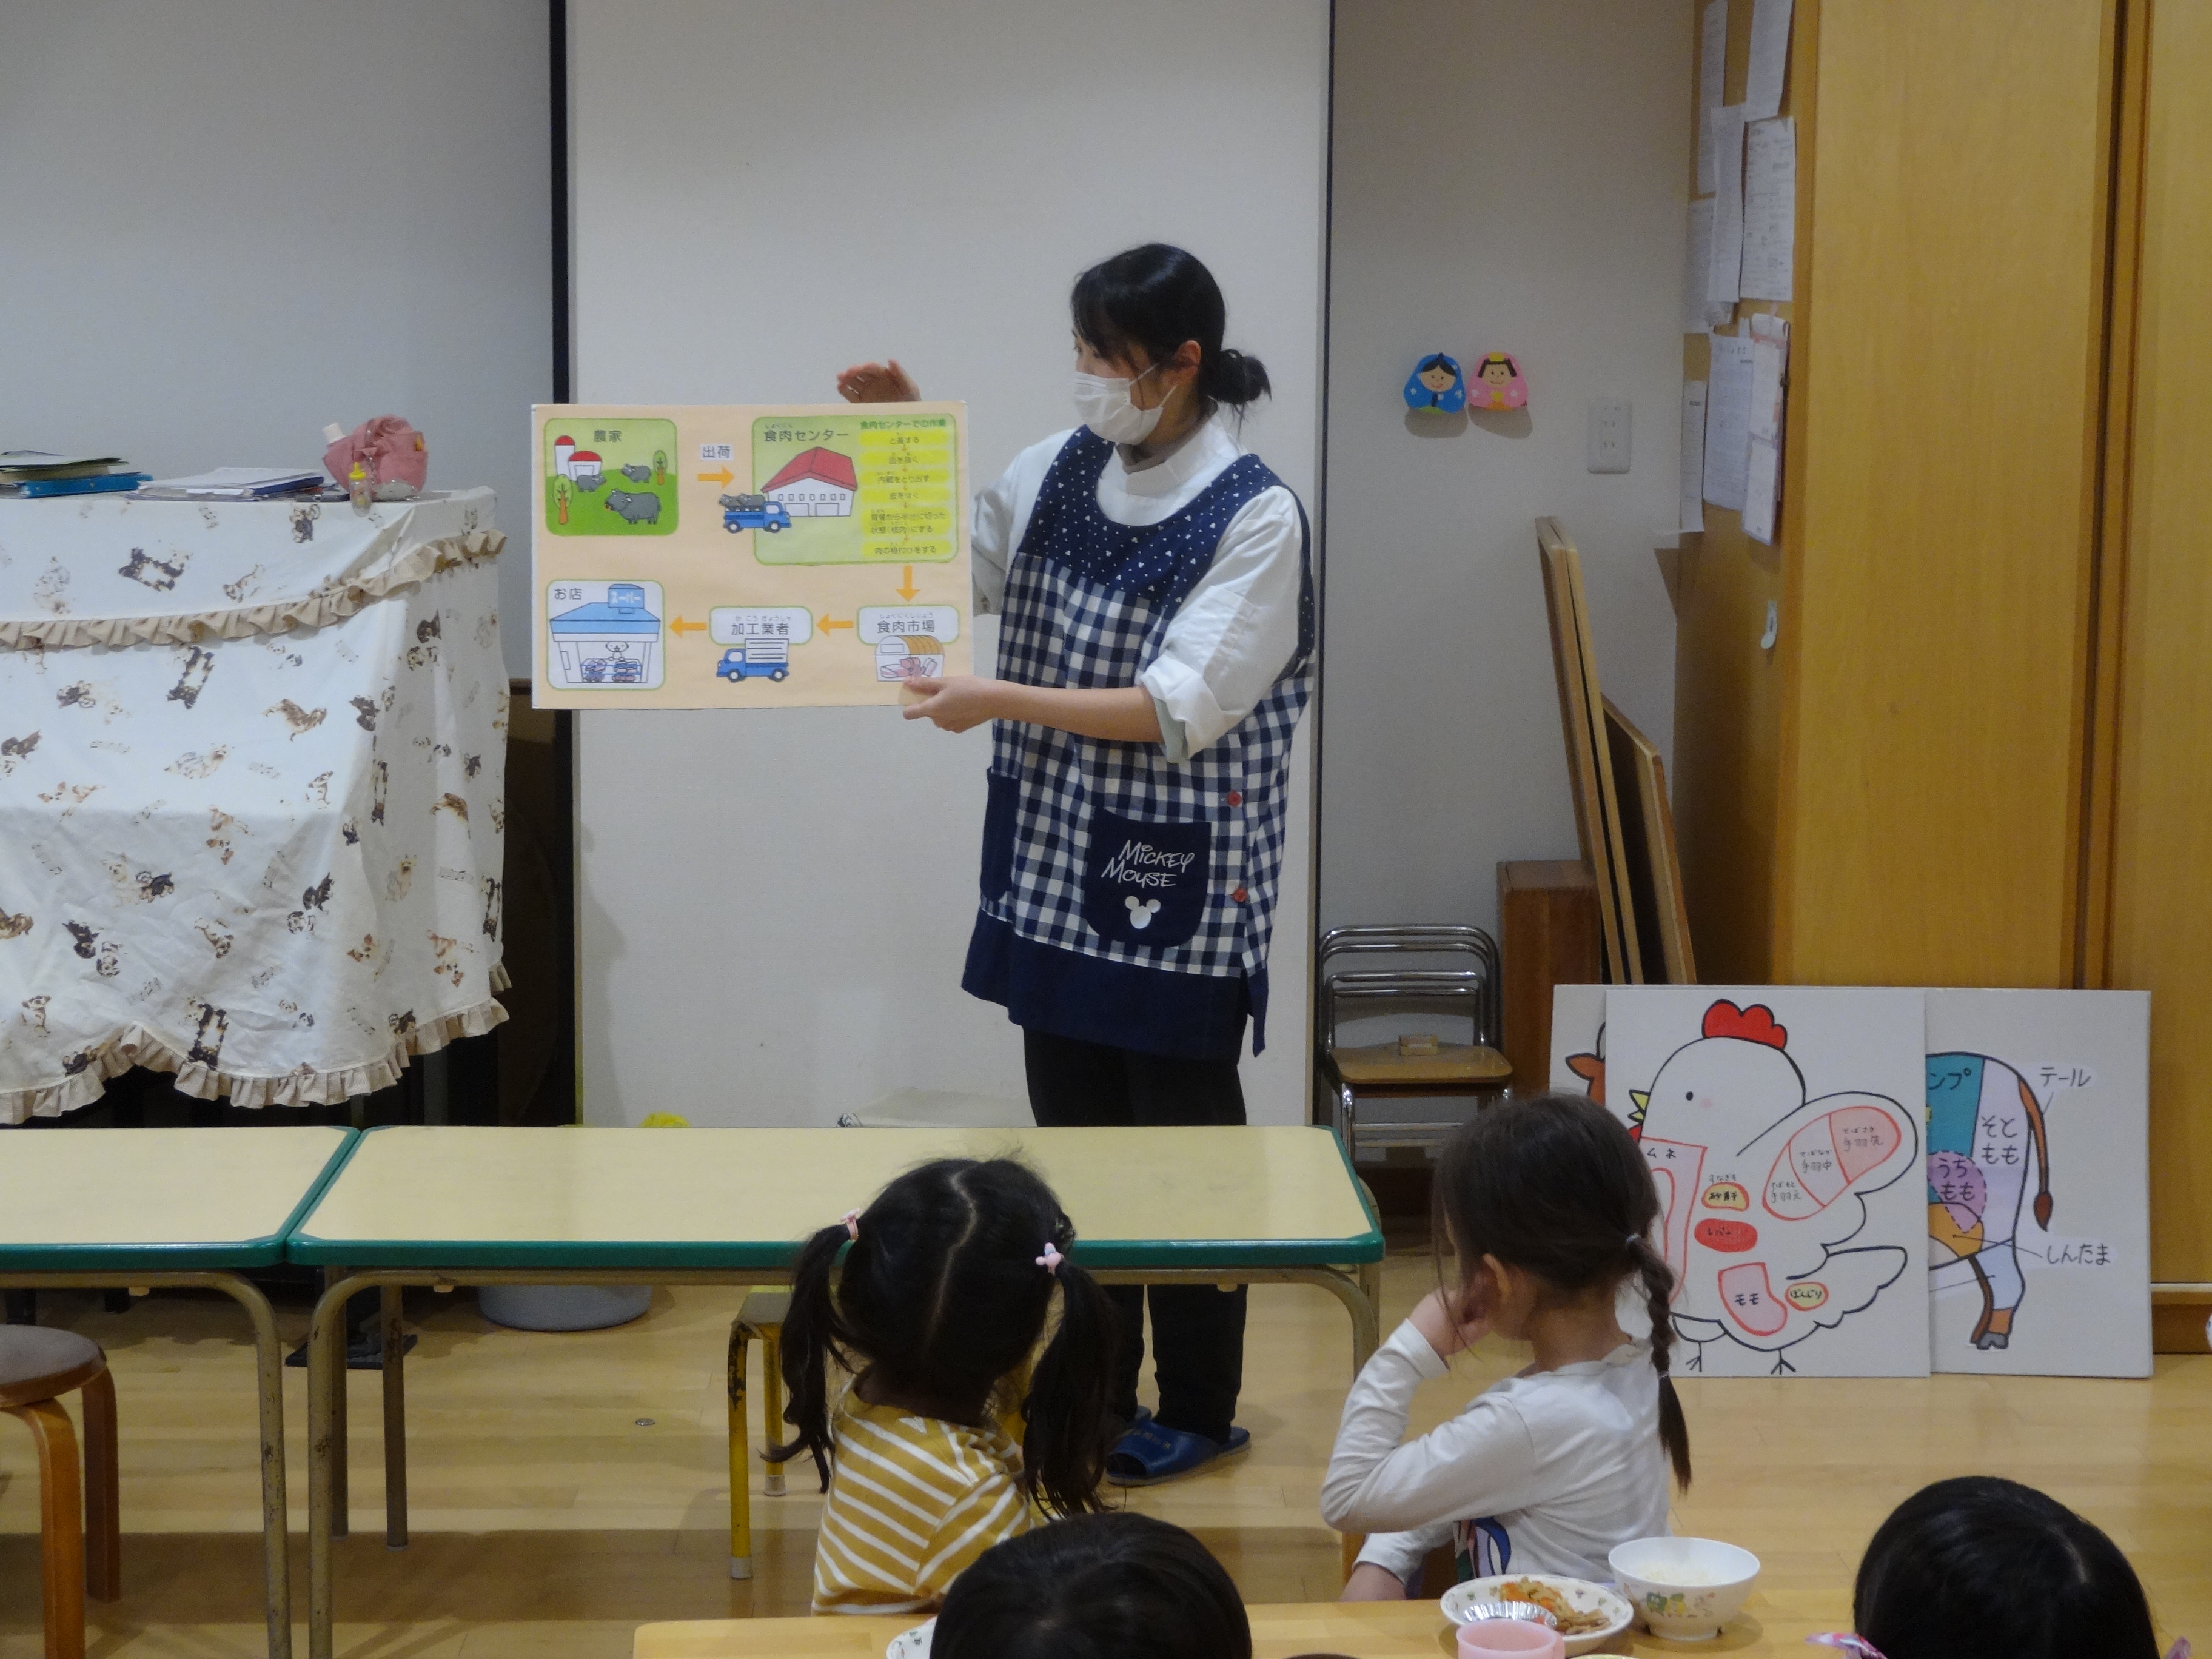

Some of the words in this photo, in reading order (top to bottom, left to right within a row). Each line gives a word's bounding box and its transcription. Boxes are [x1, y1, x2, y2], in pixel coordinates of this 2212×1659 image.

[594, 429, 622, 443] 農家
[764, 429, 849, 442] 食肉センター
[702, 445, 731, 459] 出荷
[554, 588, 583, 600] お店
[611, 591, 642, 603] スーパー
[731, 623, 789, 635] 加工業者
[877, 619, 936, 634] 食肉市場
[2039, 1066, 2091, 1087] テール
[1980, 1114, 2018, 1138] そと
[1843, 1134, 1884, 1152] 手羽先
[1981, 1142, 2020, 1165] もも
[1802, 1159, 1832, 1174] 手羽中
[1937, 1157, 1968, 1178] うち
[1771, 1189, 1802, 1203] 手羽元
[1940, 1181, 1976, 1201] もも
[2046, 1242, 2111, 1265] しんたま
[1735, 1293, 1759, 1306] モモ
